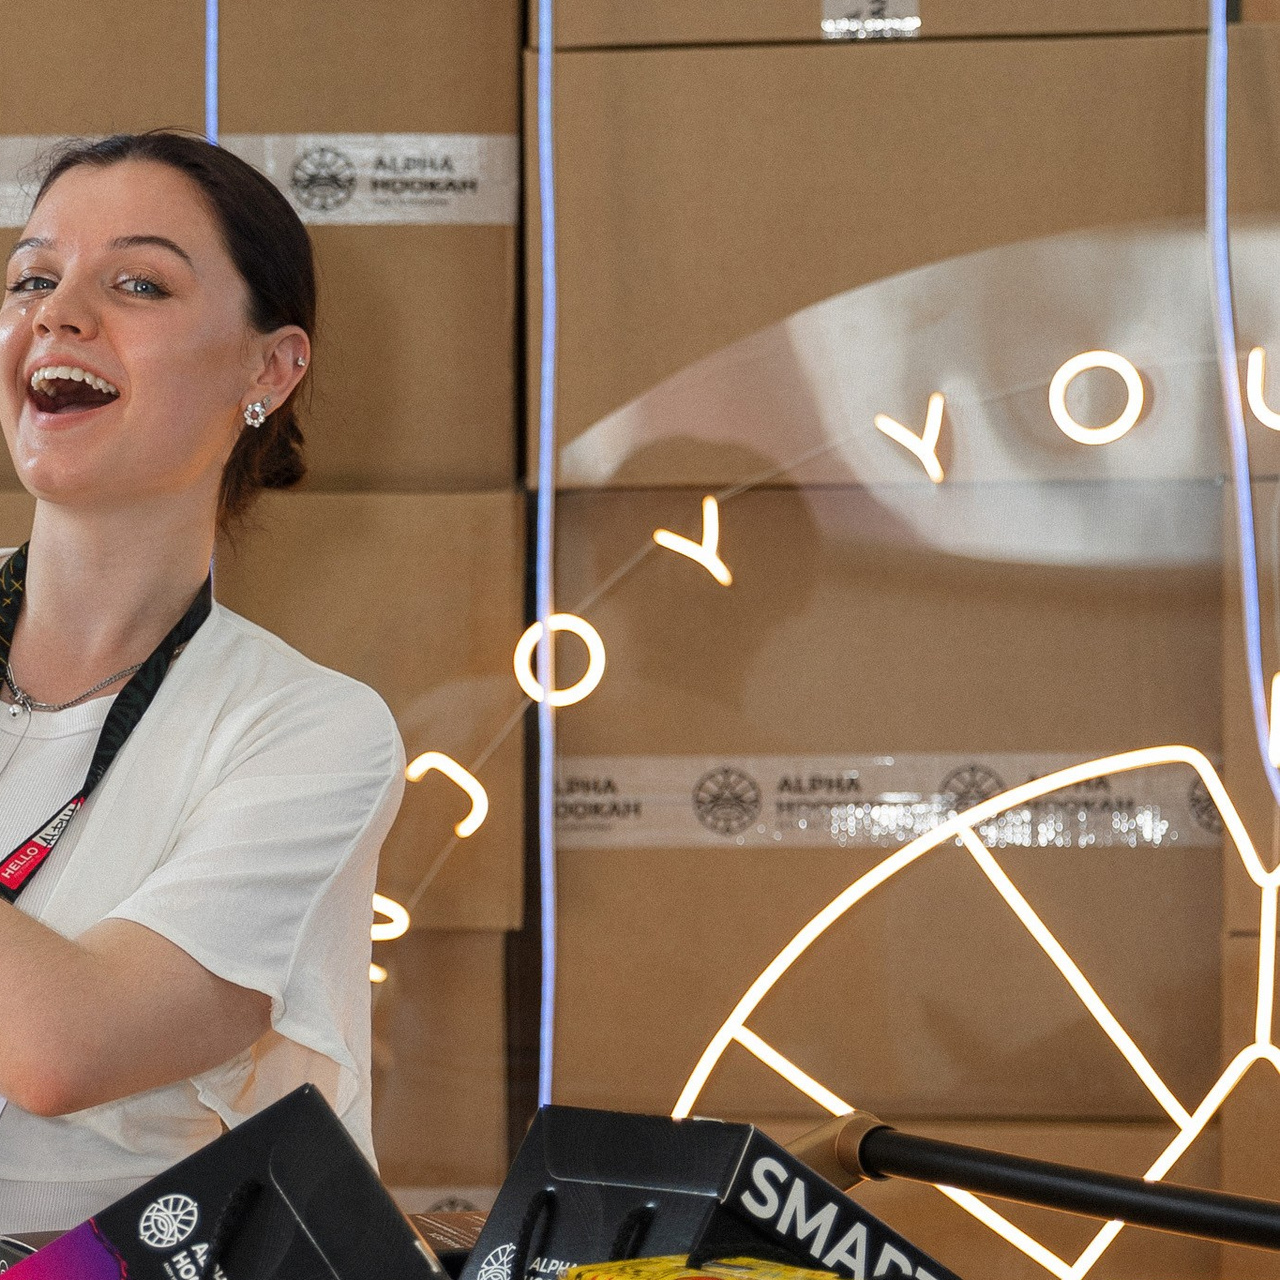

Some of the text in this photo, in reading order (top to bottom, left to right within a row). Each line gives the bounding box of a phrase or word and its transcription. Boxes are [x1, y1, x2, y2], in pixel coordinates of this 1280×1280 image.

[373, 154, 453, 173] ALPHA
[370, 177, 478, 195] HOOKAH
[777, 776, 861, 794] ALPHA
[1, 844, 40, 881] HELLO
